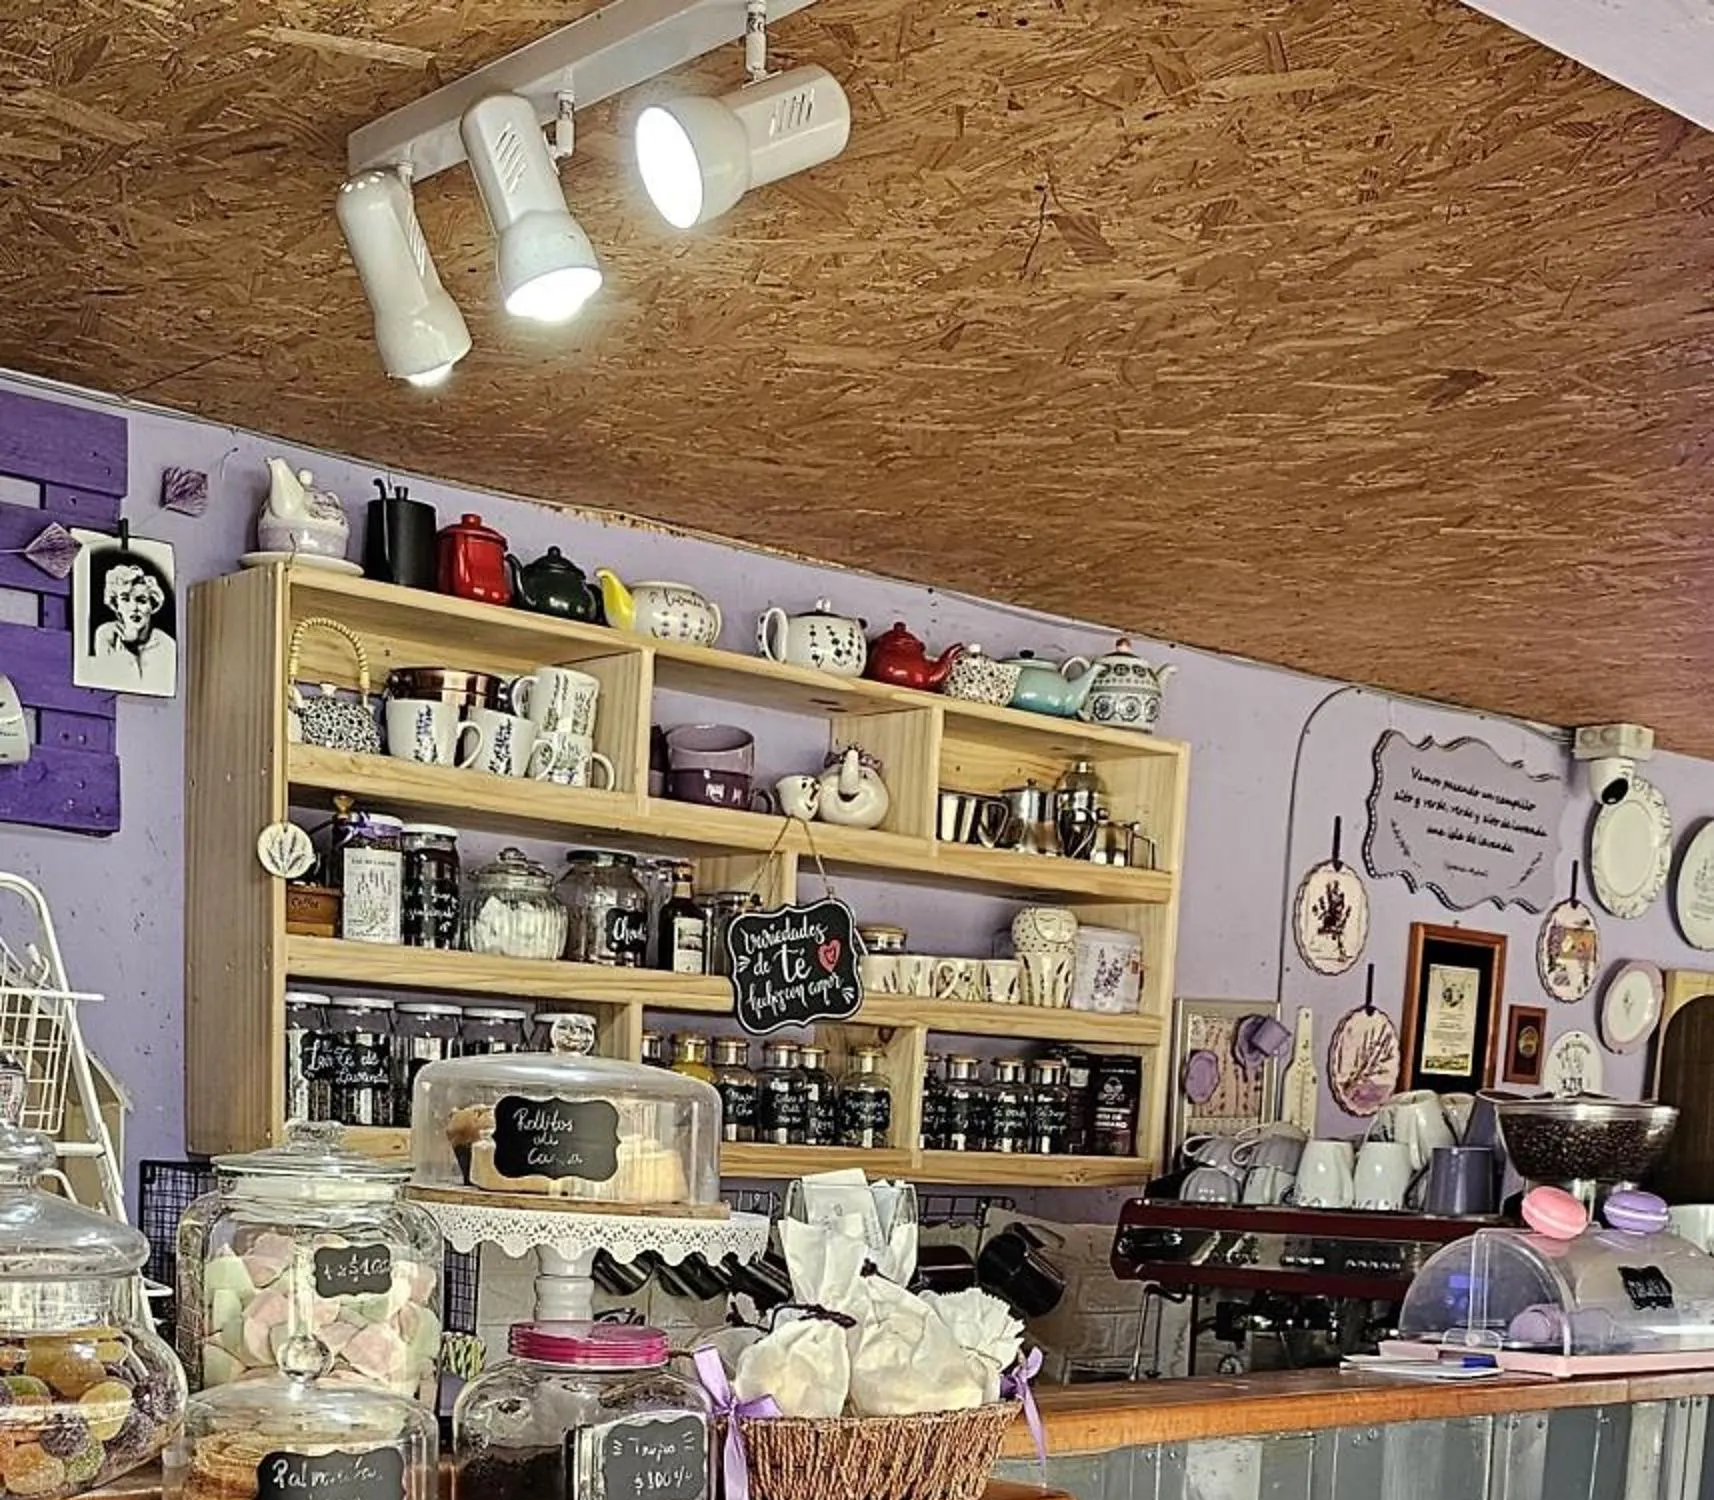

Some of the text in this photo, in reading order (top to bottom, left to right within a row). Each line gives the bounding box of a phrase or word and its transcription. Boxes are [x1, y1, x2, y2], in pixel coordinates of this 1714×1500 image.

[739, 914, 829, 955] Variedades
[753, 943, 812, 983] de té
[512, 1107, 574, 1132] Rollitos
